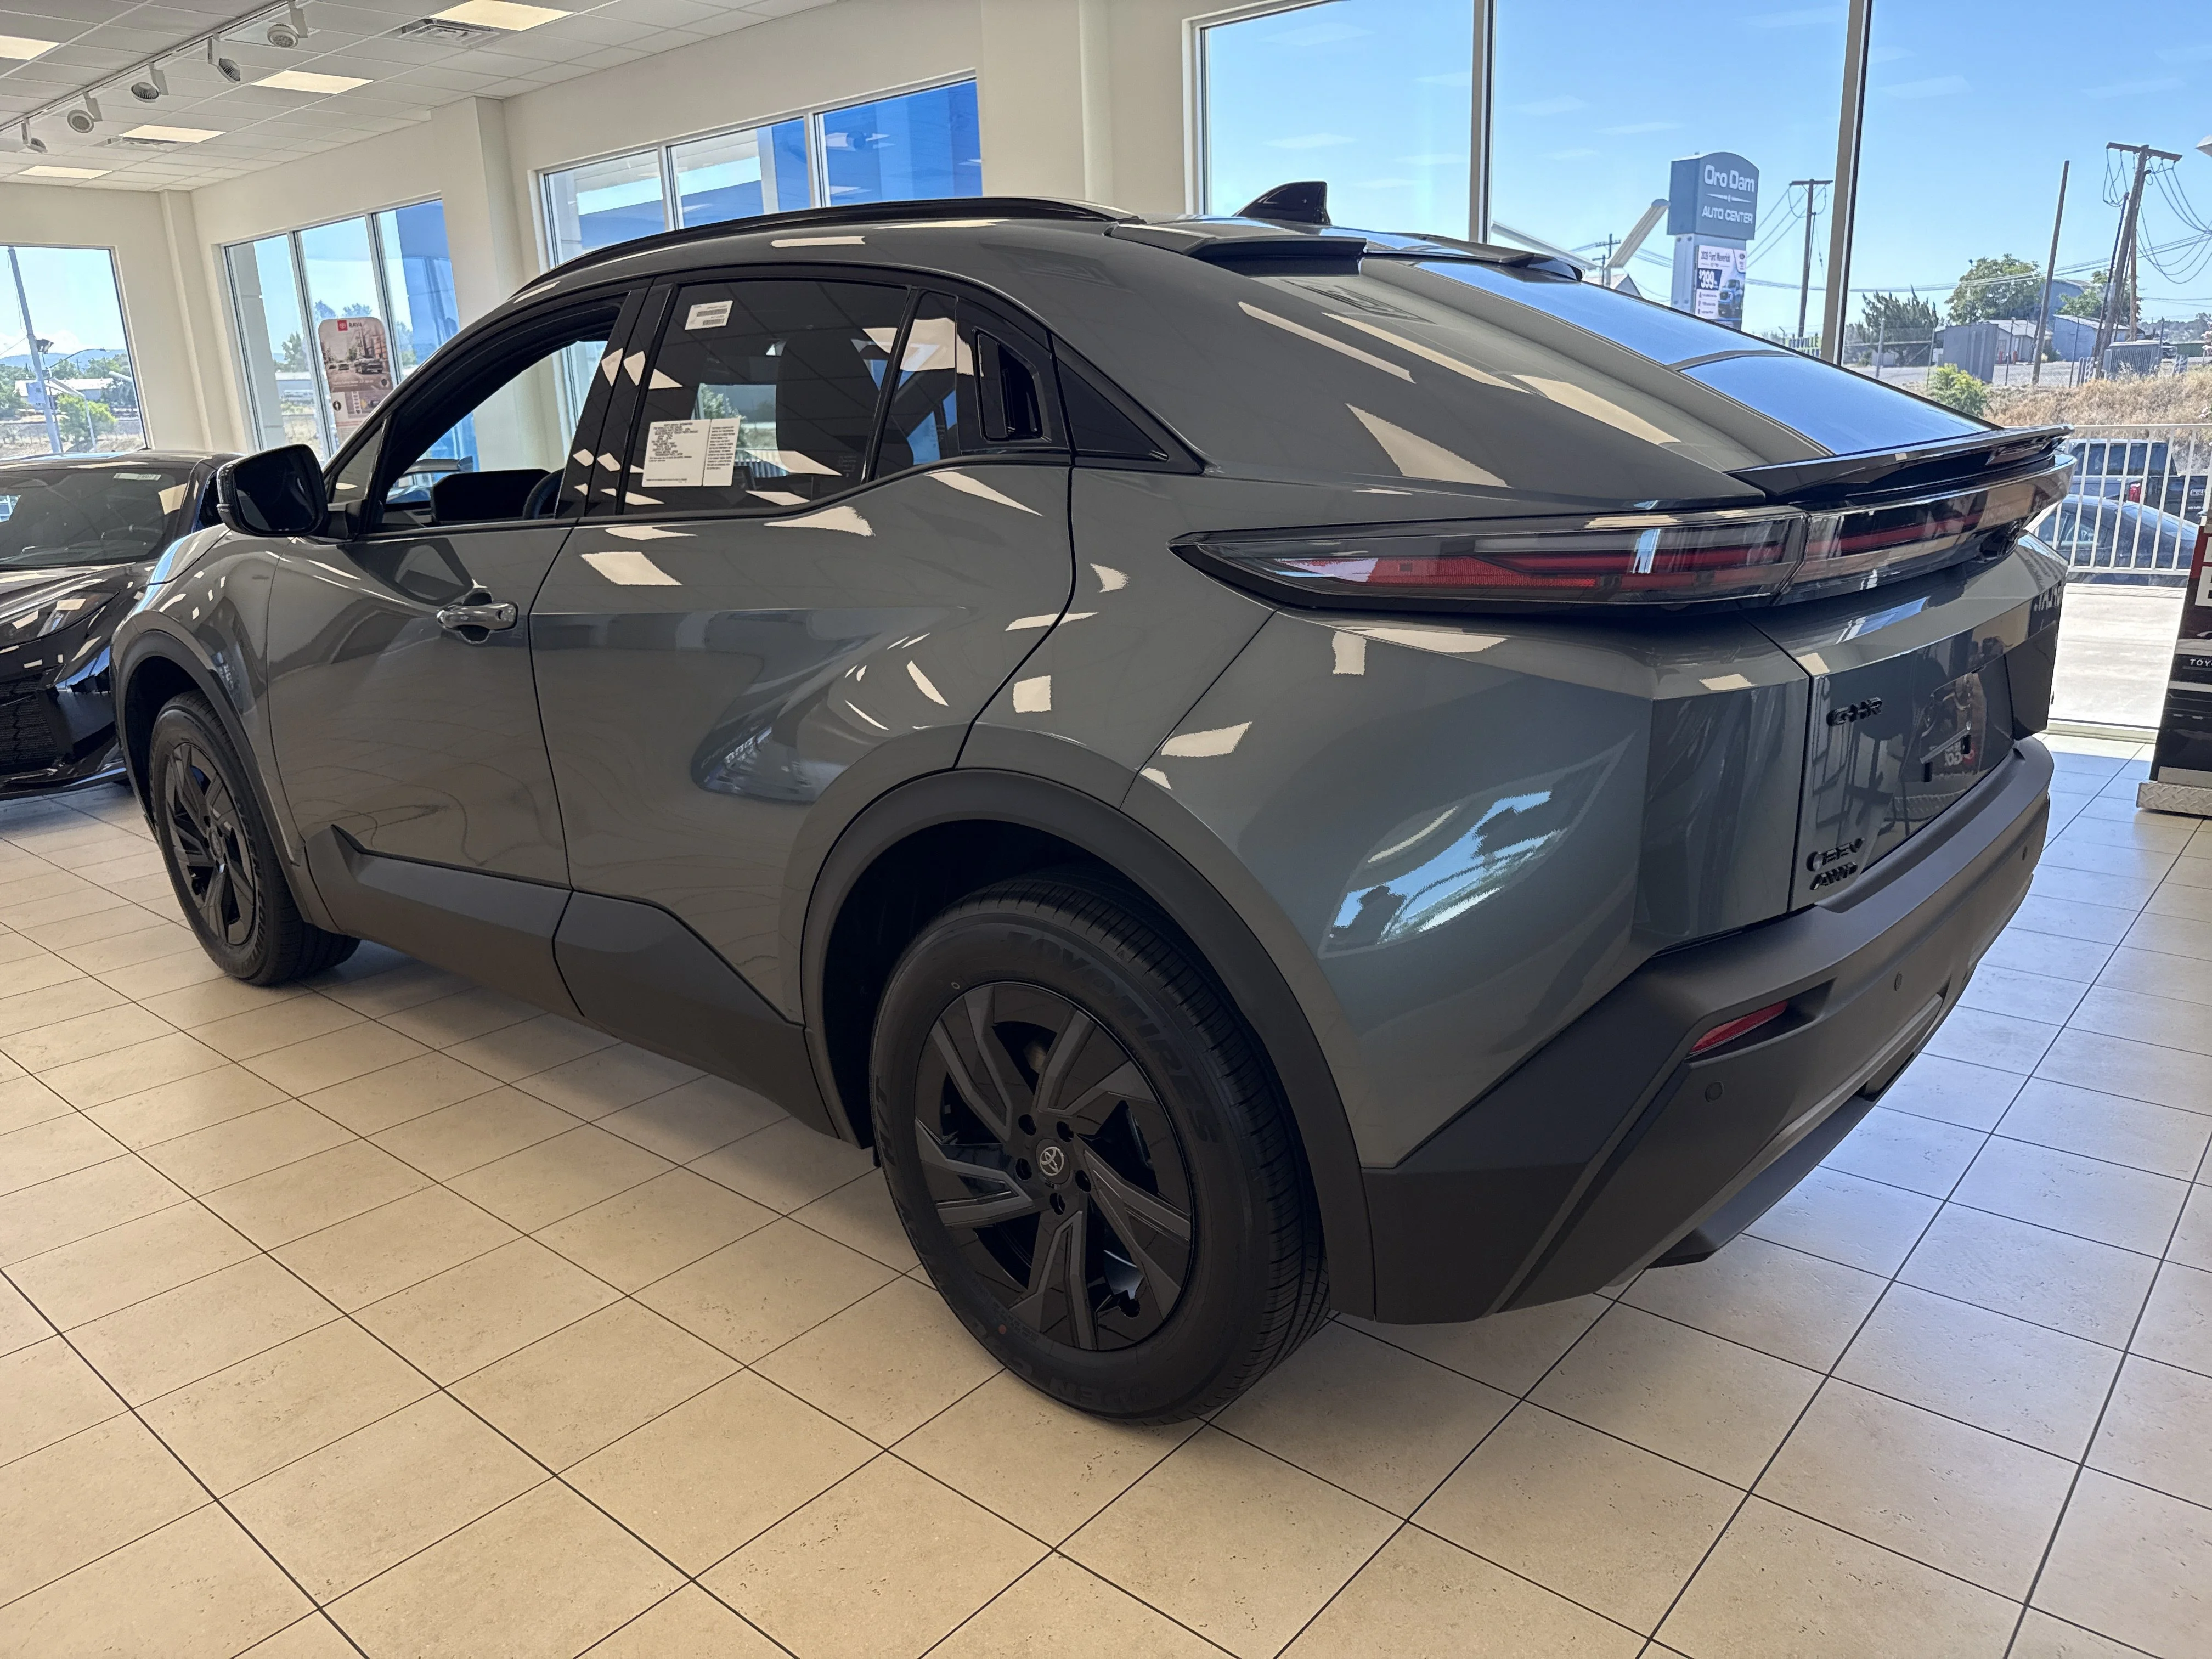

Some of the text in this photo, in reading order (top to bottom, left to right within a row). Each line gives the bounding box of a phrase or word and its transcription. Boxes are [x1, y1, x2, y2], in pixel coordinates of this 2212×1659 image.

[1704, 165, 1755, 193] Oro Dam
[1702, 206, 1753, 224] AUTO CENTER
[2190, 658, 2212, 667] TOY
[1826, 697, 1882, 727] C-HR
[1809, 861, 1858, 891] AWD
[1007, 929, 1221, 1144] TOYO TIRES
